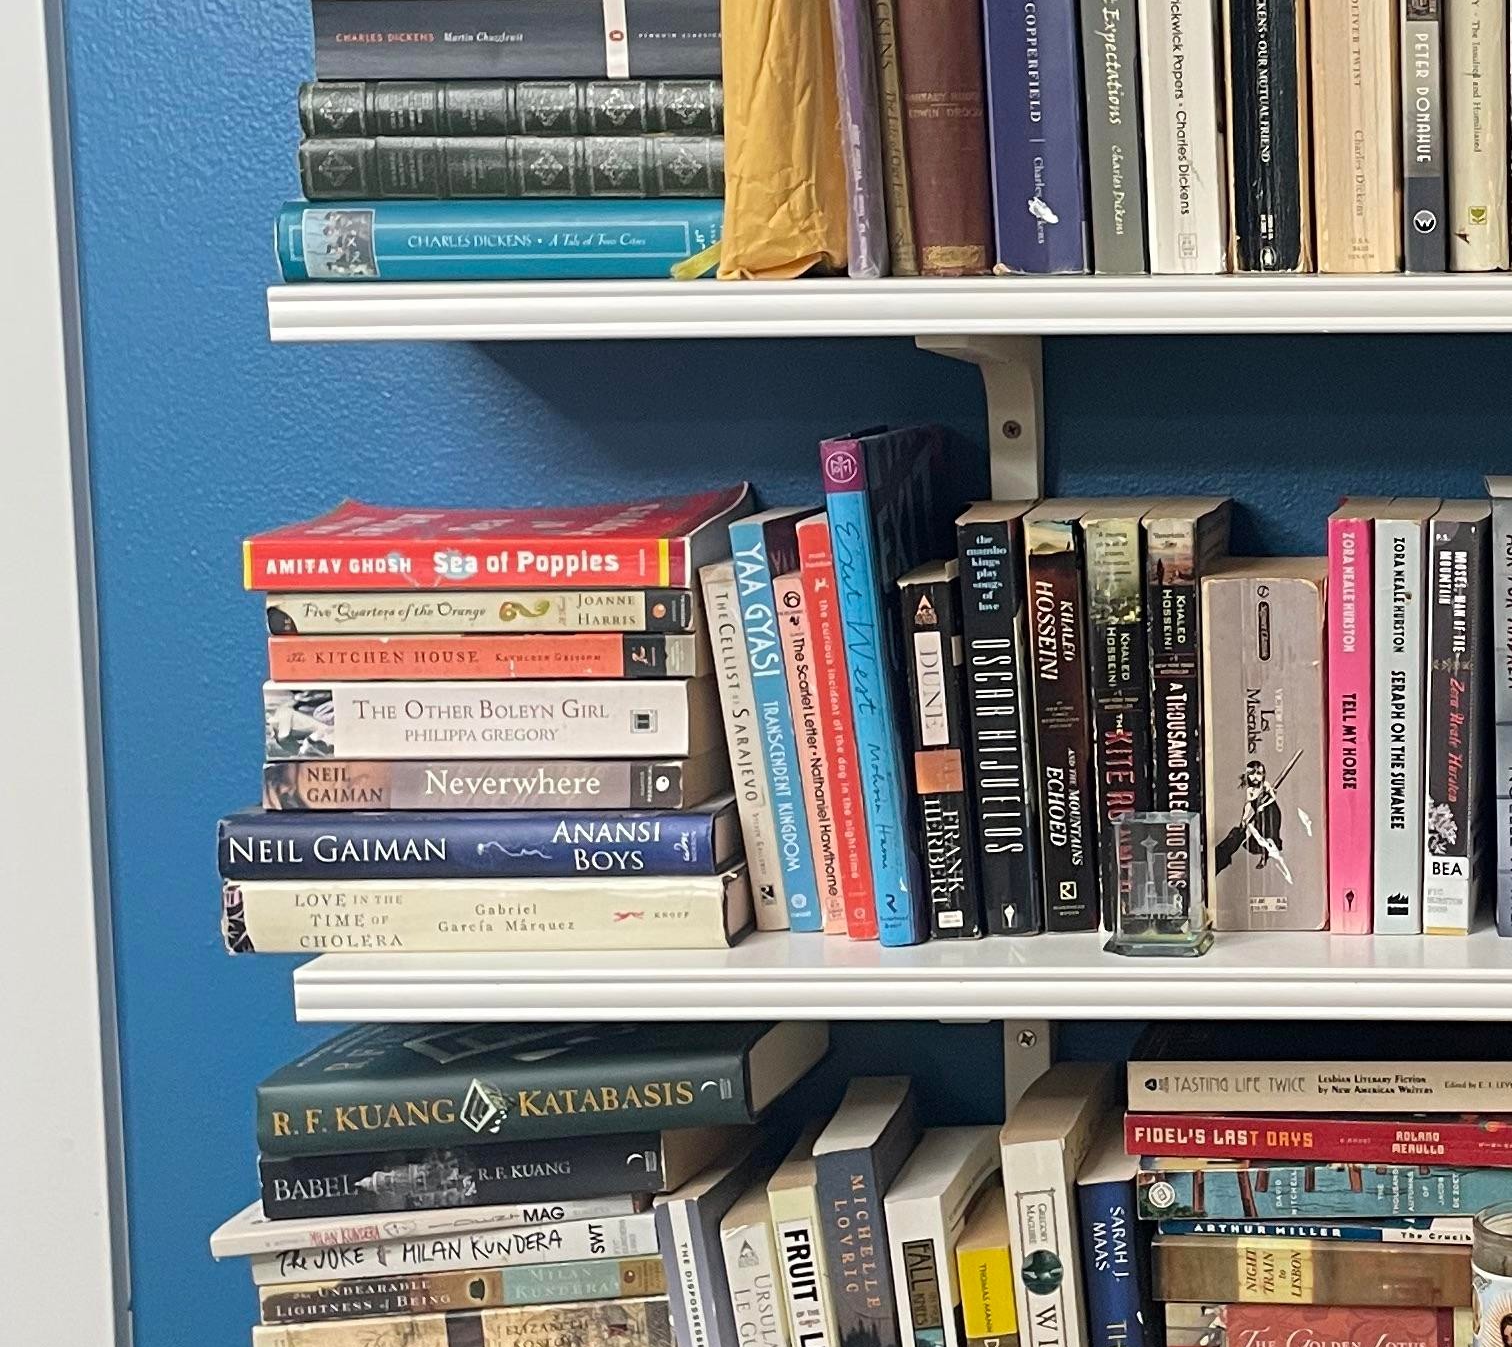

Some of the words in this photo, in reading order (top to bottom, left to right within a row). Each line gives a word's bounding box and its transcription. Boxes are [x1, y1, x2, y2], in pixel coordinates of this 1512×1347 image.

[1025, 3, 1042, 123] COPPERFIELD
[1172, 53, 1186, 100] Papers
[1175, 110, 1188, 167] Charles
[1177, 167, 1192, 216] Dickens
[266, 558, 343, 576] AMITAV
[349, 557, 413, 574] GHOSH
[433, 551, 479, 573] Sea
[487, 550, 509, 574] of
[517, 549, 620, 575] Poppies
[734, 542, 770, 596] YAA
[745, 600, 781, 678] GYASI
[352, 700, 397, 719] THE
[404, 699, 474, 720] OTHER
[479, 698, 556, 719] BOLEYN
[561, 698, 610, 719] GIRL
[1342, 693, 1357, 724] TELL
[1342, 725, 1357, 743] MY
[424, 770, 601, 796] Neverwhere
[1342, 745, 1358, 791] HORSE
[552, 821, 661, 844] ANANSI
[228, 838, 304, 864] NEIL
[312, 836, 449, 863] GAIMAN
[574, 850, 645, 872] BOYS
[1432, 861, 1463, 878] BEA
[518, 1082, 695, 1117] KATABASIS
[273, 1109, 300, 1136] R.
[305, 1107, 328, 1134] F.
[335, 1098, 456, 1131] KUANG
[1134, 1127, 1208, 1145] FIDEL'S
[1213, 1129, 1260, 1146] LAST
[1266, 1130, 1313, 1147] DAYS
[522, 1207, 565, 1222] MAG
[784, 1230, 817, 1302] FRUIT
